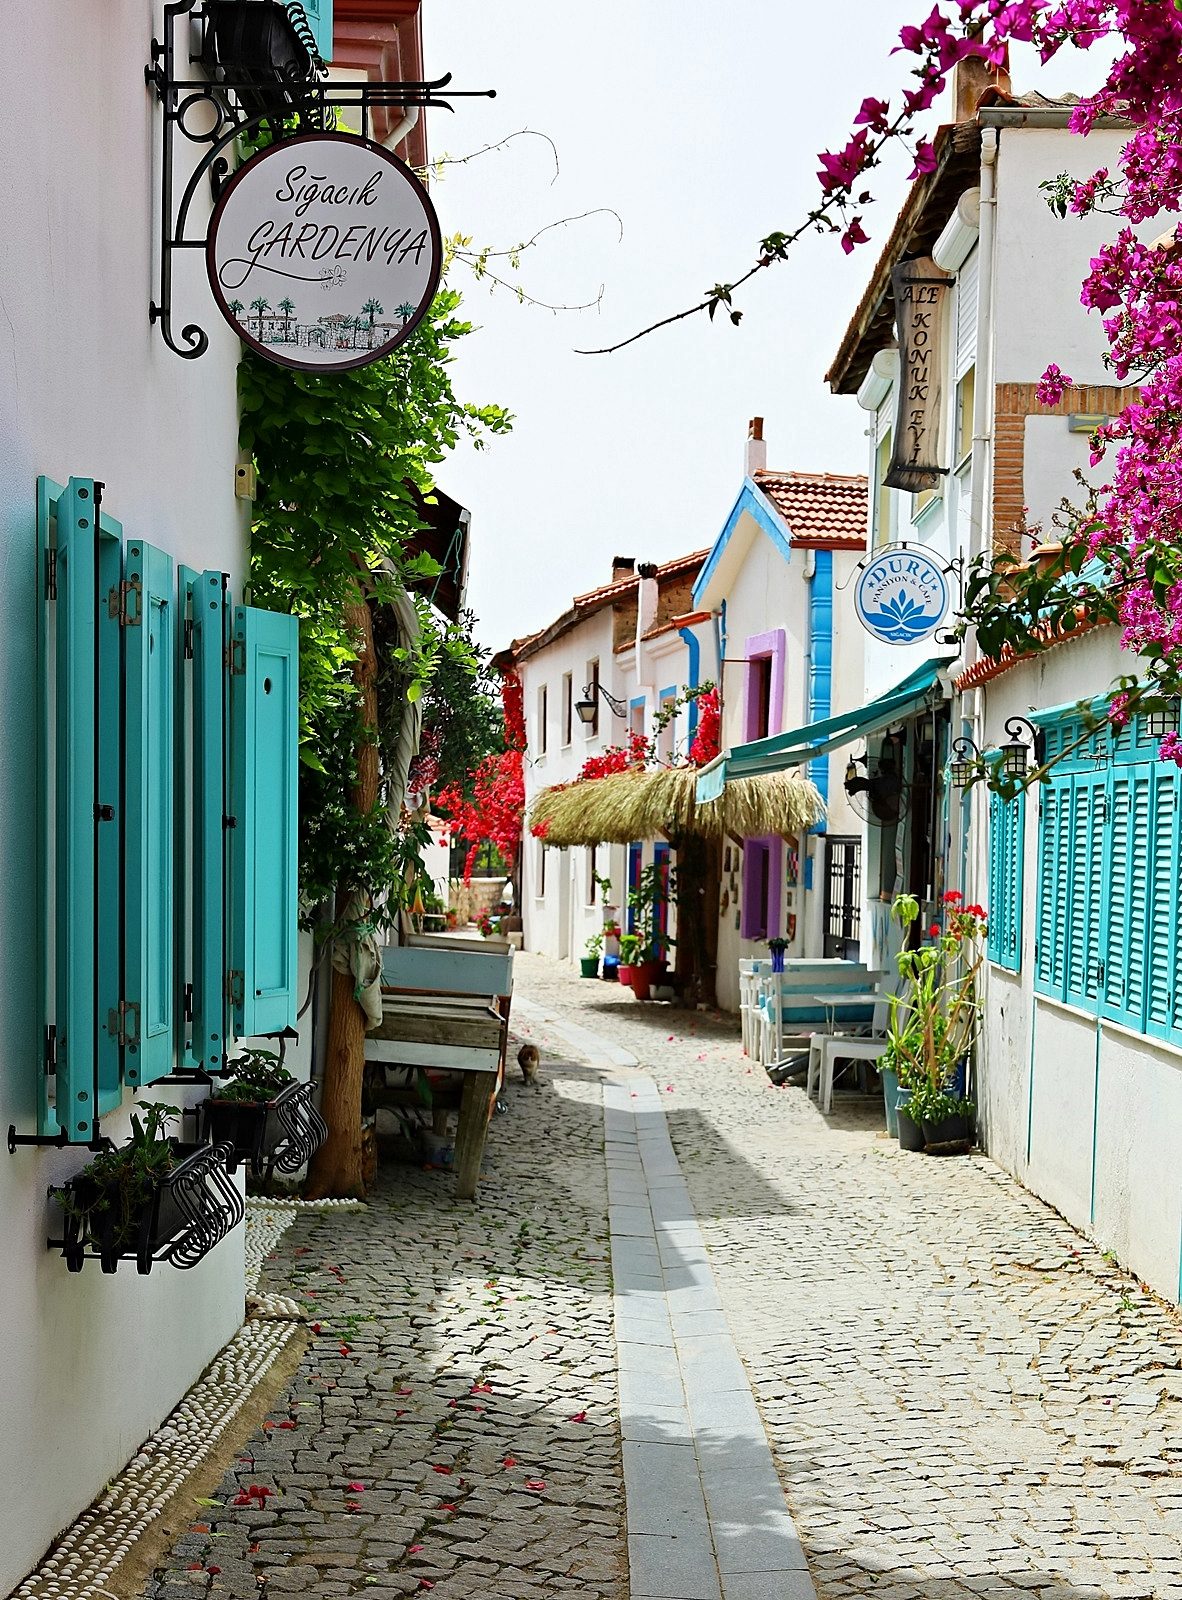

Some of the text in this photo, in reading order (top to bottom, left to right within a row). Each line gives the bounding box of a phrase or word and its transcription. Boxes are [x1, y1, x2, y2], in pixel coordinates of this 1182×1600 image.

[275, 165, 383, 217] Sığacık
[219, 221, 428, 288] GARDENYA
[900, 285, 940, 304] ALE
[908, 313, 932, 401] KONUK
[871, 559, 936, 585] DURU
[918, 584, 932, 605] CAFE
